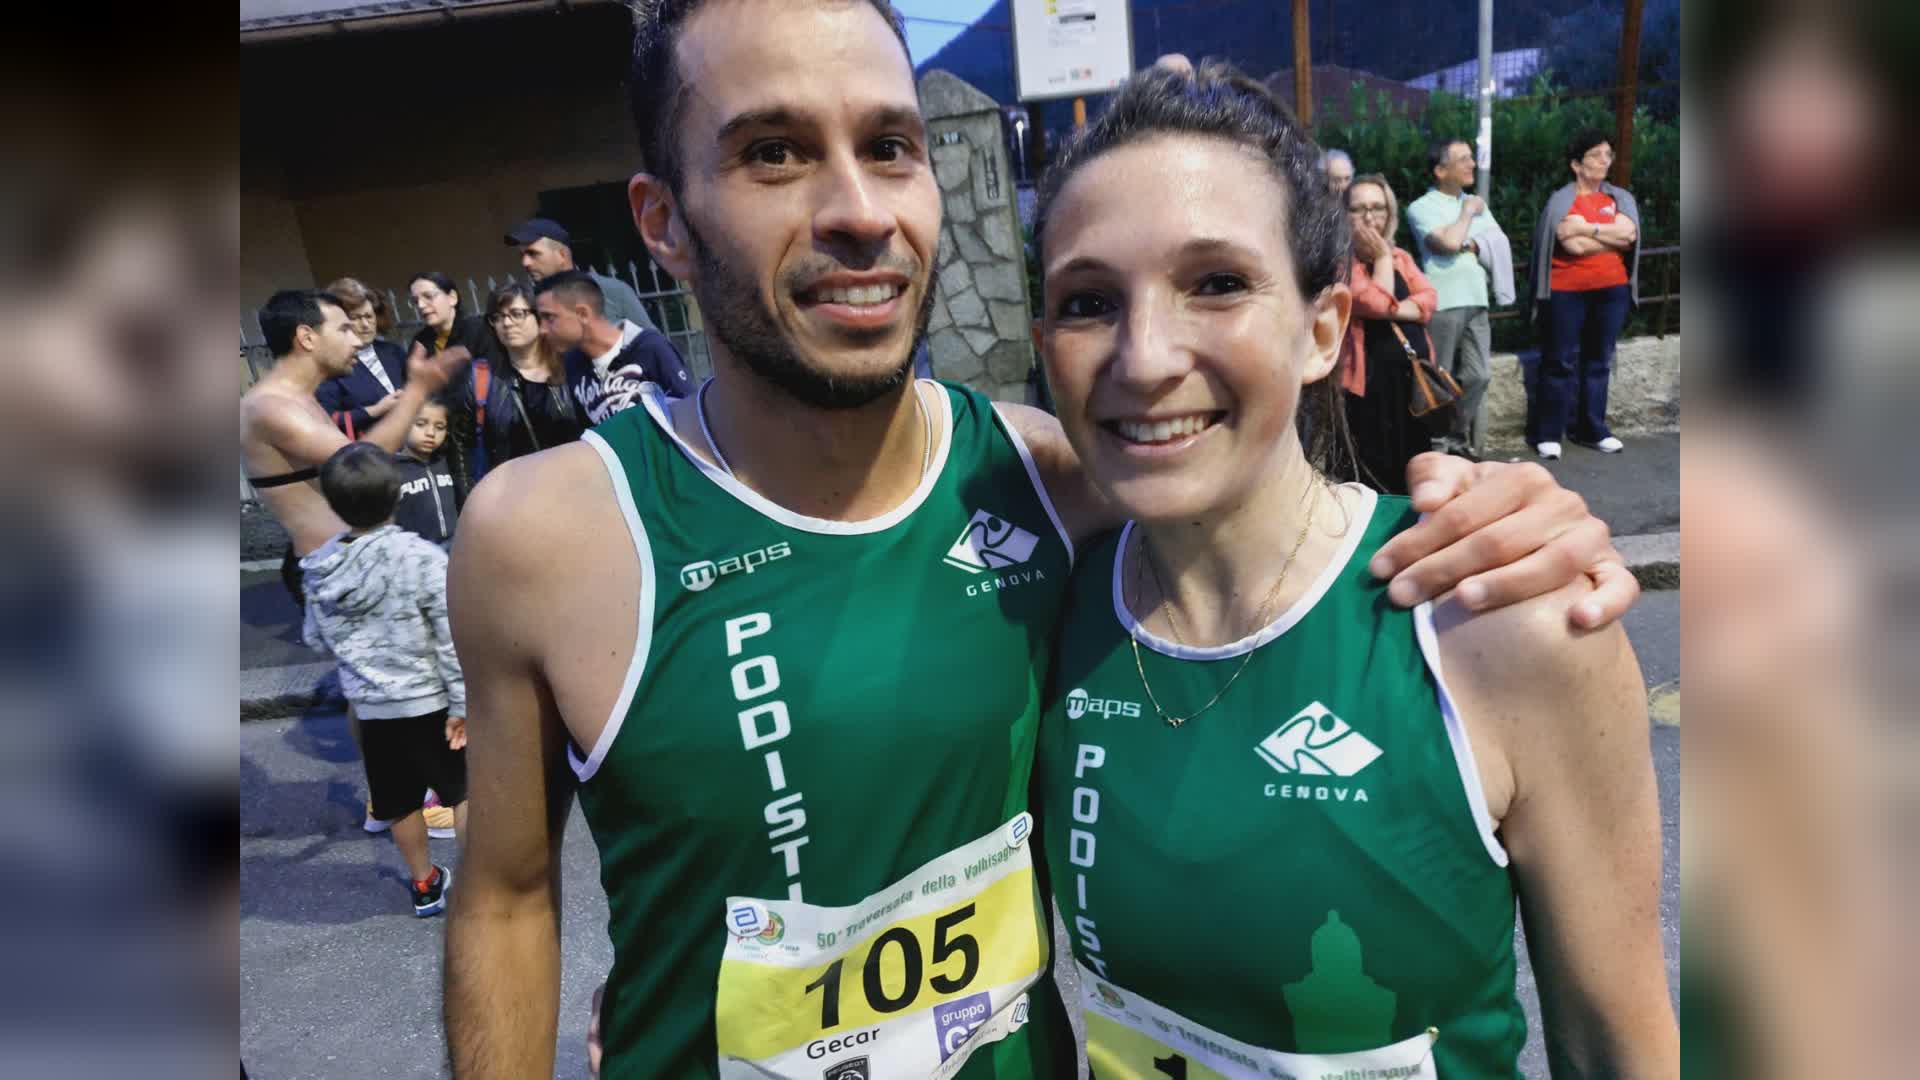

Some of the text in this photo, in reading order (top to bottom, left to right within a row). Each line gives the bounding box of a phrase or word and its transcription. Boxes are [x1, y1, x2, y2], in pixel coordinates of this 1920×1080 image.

[680, 541, 791, 591] maps
[966, 570, 1045, 597] GENOVA
[1066, 688, 1141, 719] maps
[1264, 783, 1368, 802] GENOVA
[846, 889, 913, 938] Traversata
[922, 874, 956, 895] della
[963, 846, 1018, 880] Valbisagn
[805, 902, 980, 1029] 105
[942, 1004, 985, 1026] gruppo
[806, 1028, 880, 1060] Gecar
